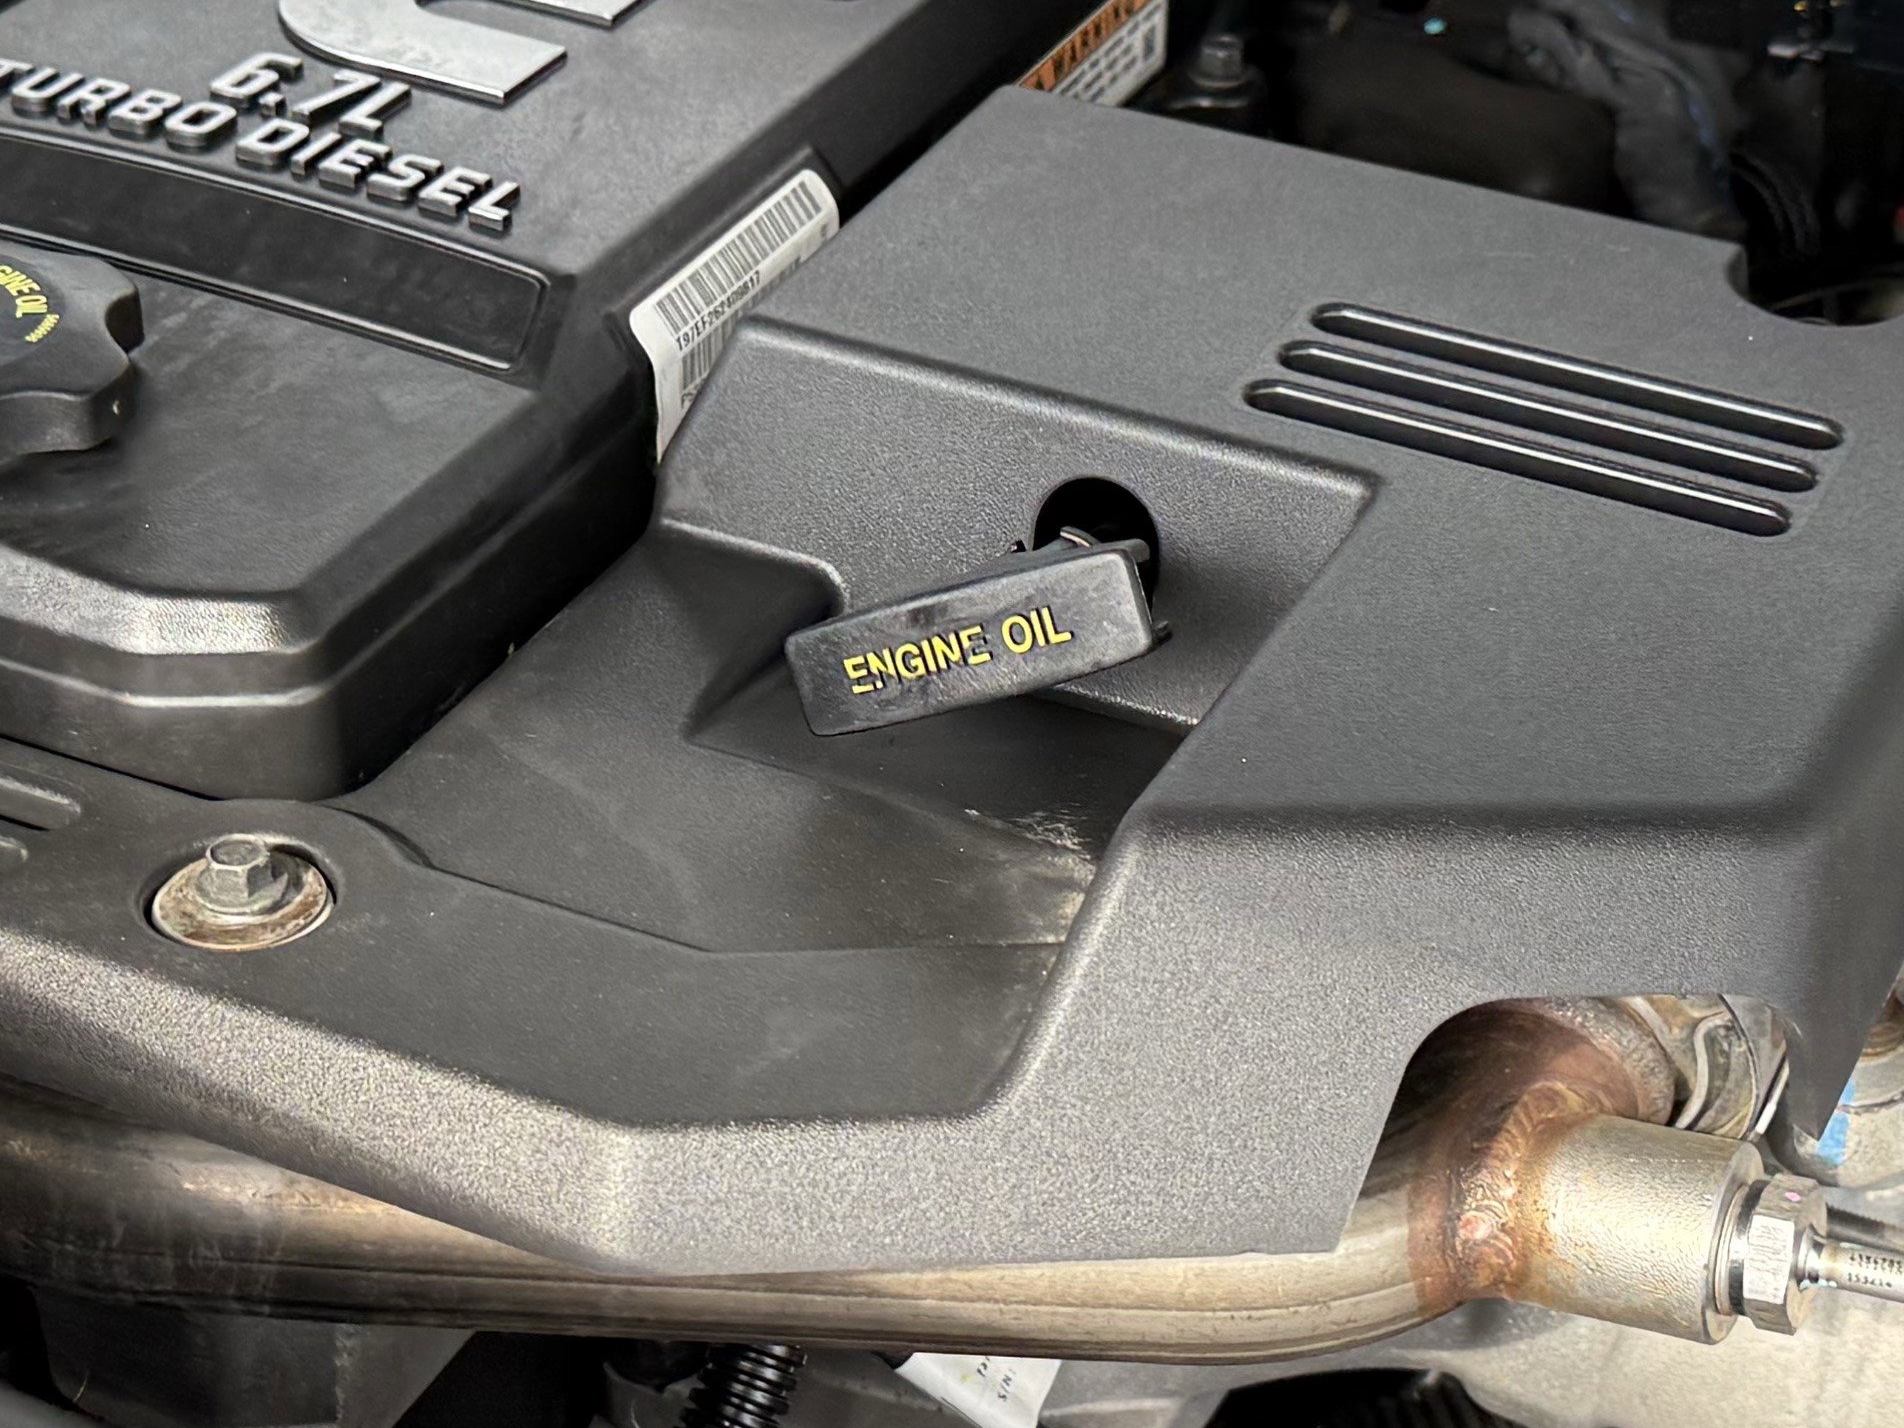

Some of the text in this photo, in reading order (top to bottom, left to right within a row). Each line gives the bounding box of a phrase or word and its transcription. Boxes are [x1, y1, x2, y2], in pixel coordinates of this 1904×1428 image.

[210, 52, 413, 137] 6.7L
[236, 117, 521, 231] DIESEL
[15, 294, 49, 320] OIL
[843, 606, 1074, 695] ENGINE OIL
